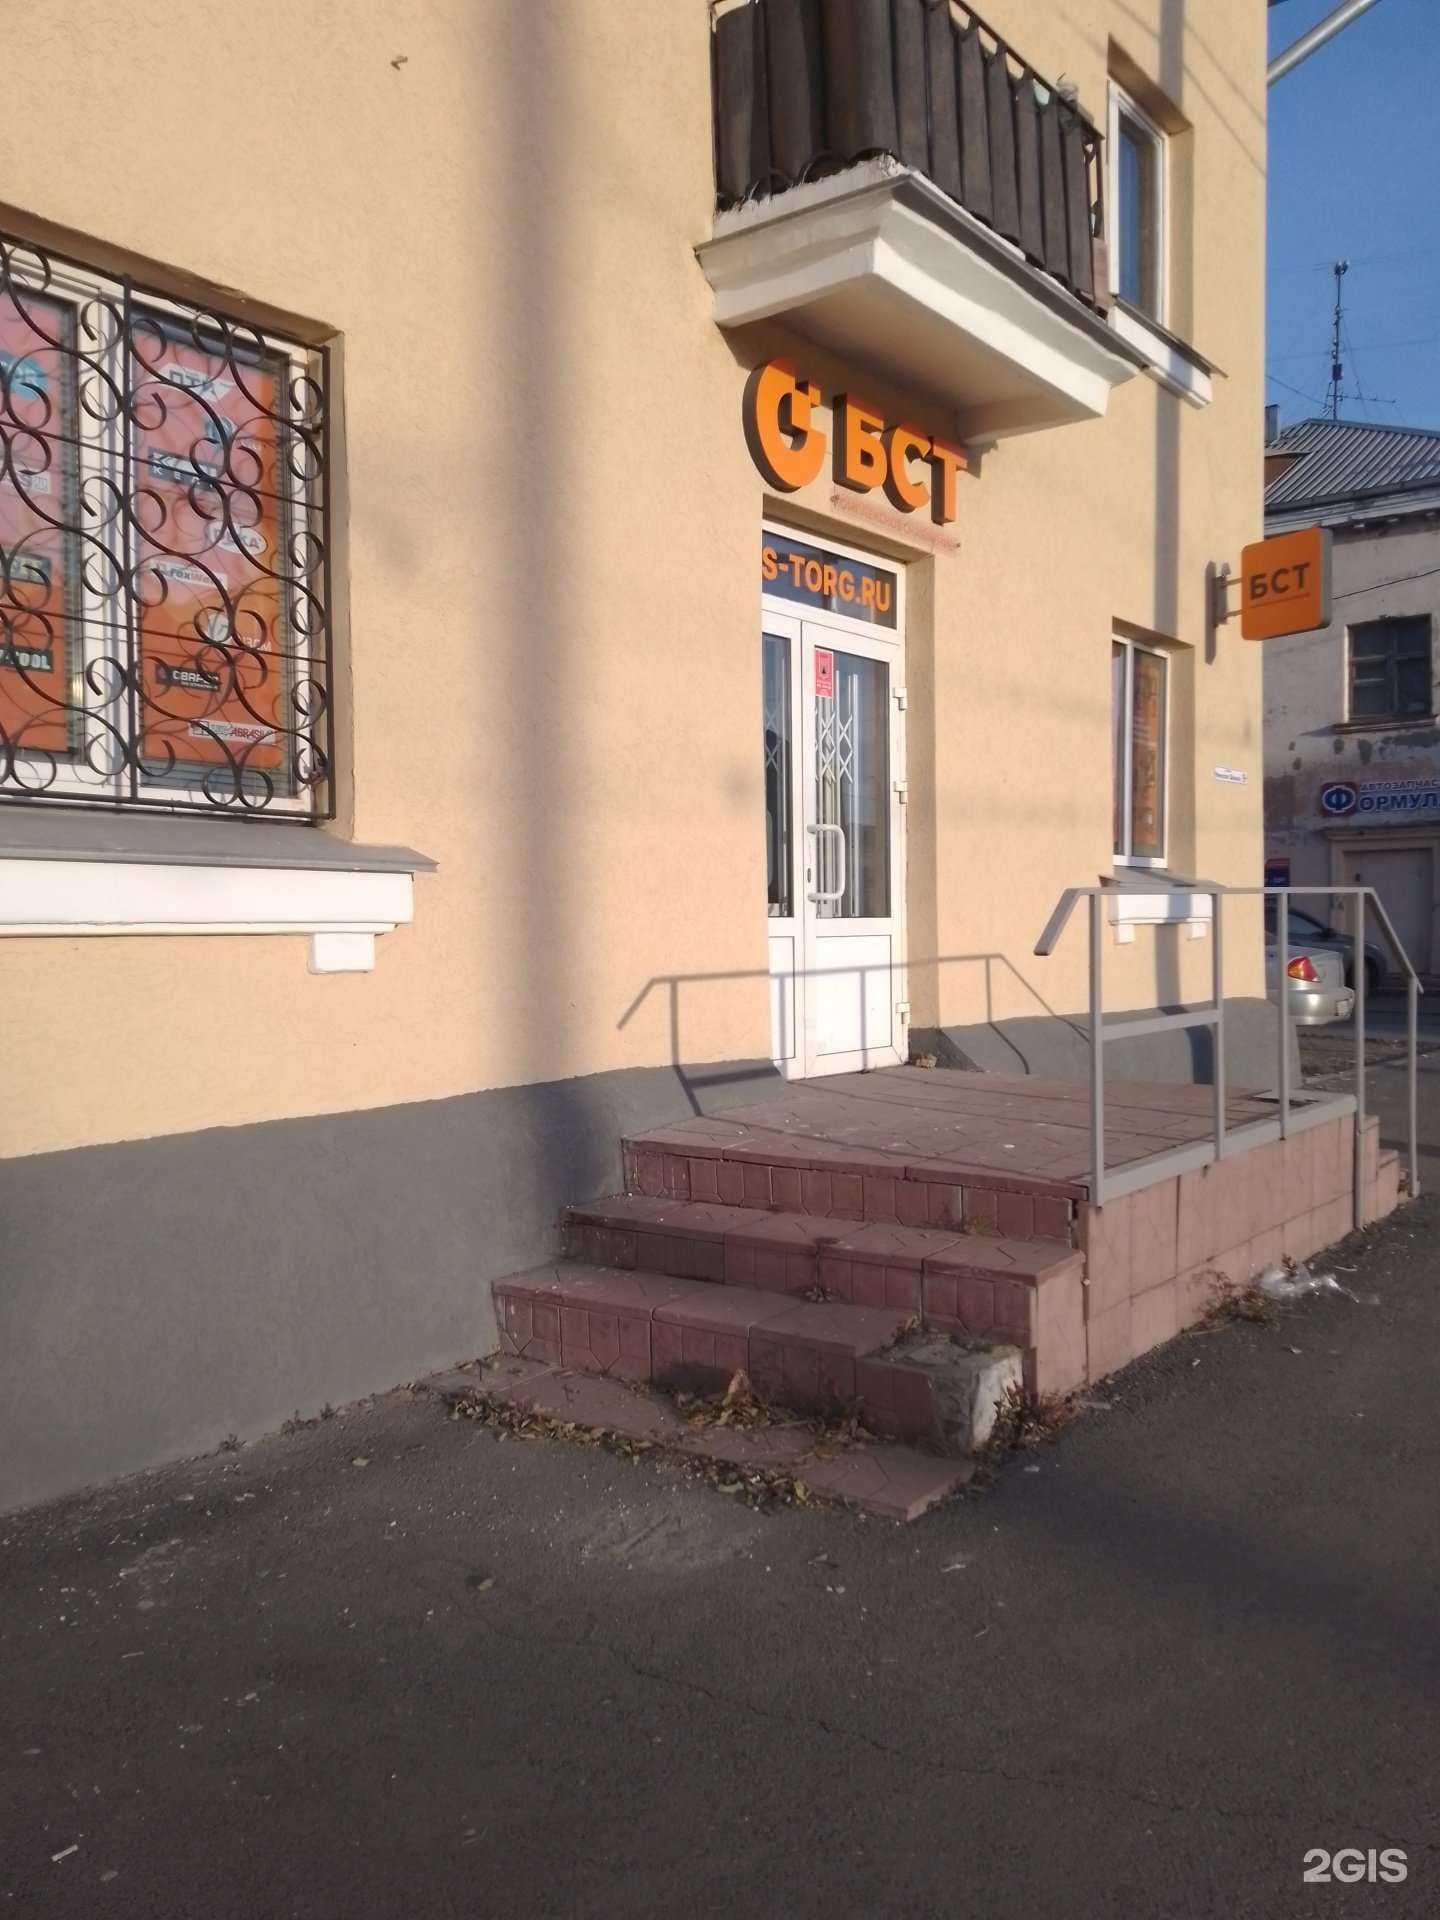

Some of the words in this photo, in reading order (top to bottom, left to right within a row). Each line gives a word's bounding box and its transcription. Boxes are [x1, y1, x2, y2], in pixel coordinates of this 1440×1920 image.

[832, 392, 968, 526] БСТ
[761, 546, 891, 612] S-TORG.RU
[1250, 561, 1311, 600] БСТ
